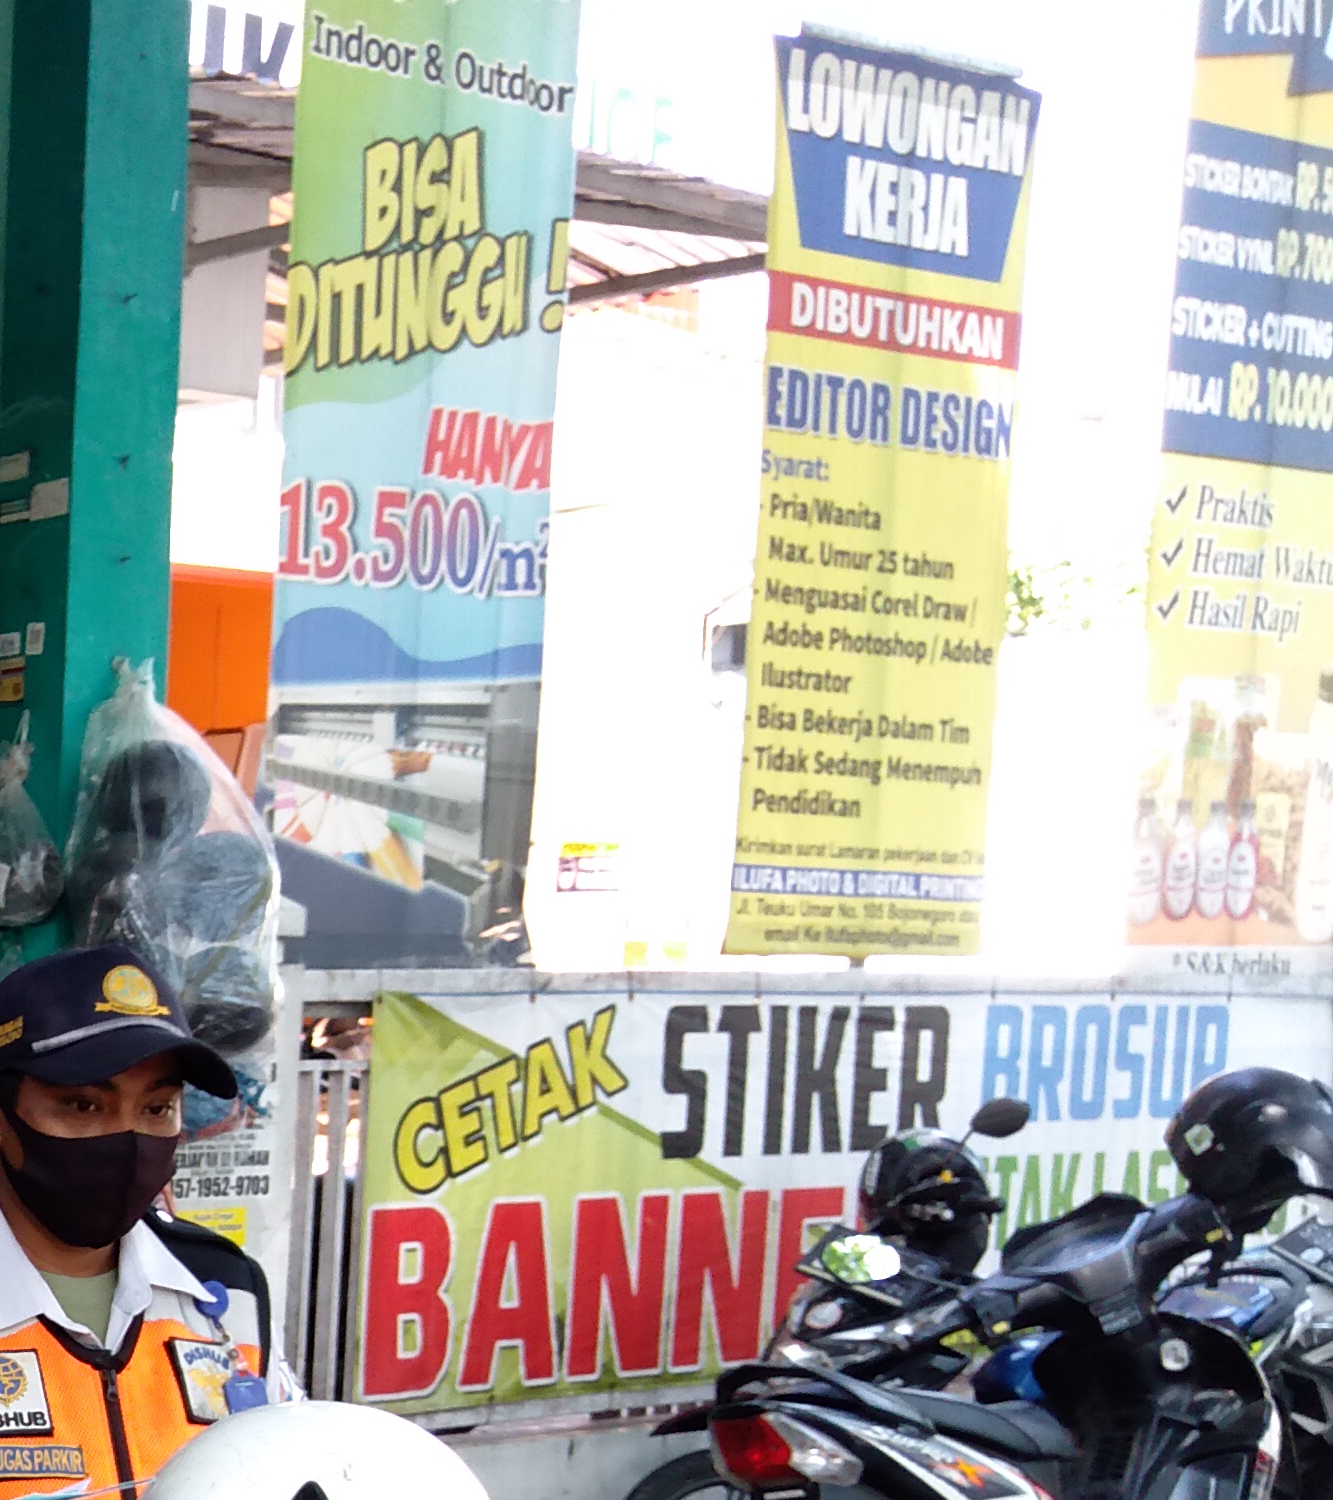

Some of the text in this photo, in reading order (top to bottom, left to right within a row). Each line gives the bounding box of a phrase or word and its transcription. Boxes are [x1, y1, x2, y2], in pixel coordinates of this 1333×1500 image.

[312, 15, 574, 113] Indoor & Outdoor
[788, 48, 1031, 176] LOWONGAN
[363, 127, 485, 253] BISA
[844, 156, 968, 257] KERJA
[285, 230, 531, 377] DITUNGGU
[790, 281, 1004, 360] DIBUTUHKAN
[1172, 296, 1248, 347] STICKER
[766, 365, 1013, 459] EDITOR DESIGN
[421, 407, 553, 490] HANYA
[761, 449, 830, 482] Syarat:
[770, 493, 882, 531] Pria/Wanita
[1195, 485, 1274, 530] Praktis
[768, 535, 954, 580] Max. Umur 25 tahun
[1191, 539, 1265, 582] Hemat
[764, 578, 868, 614] Menguasai
[871, 590, 919, 618] Corel
[922, 596, 968, 623] Draw
[1186, 592, 1302, 643] Hasil Rapi
[762, 621, 824, 651] Adobe
[828, 627, 927, 665] Photoshop
[940, 638, 994, 665] Adobe
[757, 704, 971, 744] Bisa Bekerja Dalam Tim
[754, 745, 808, 774] Tidak
[813, 750, 882, 785] Sedang
[751, 787, 861, 818] Pendidikan
[394, 1005, 627, 1194] CETAK
[661, 1005, 950, 1158] STIKER
[173, 1175, 270, 1198] 57-1952-9703
[363, 1186, 847, 1399] BANNE
[33, 1448, 83, 1472] PARKIR
